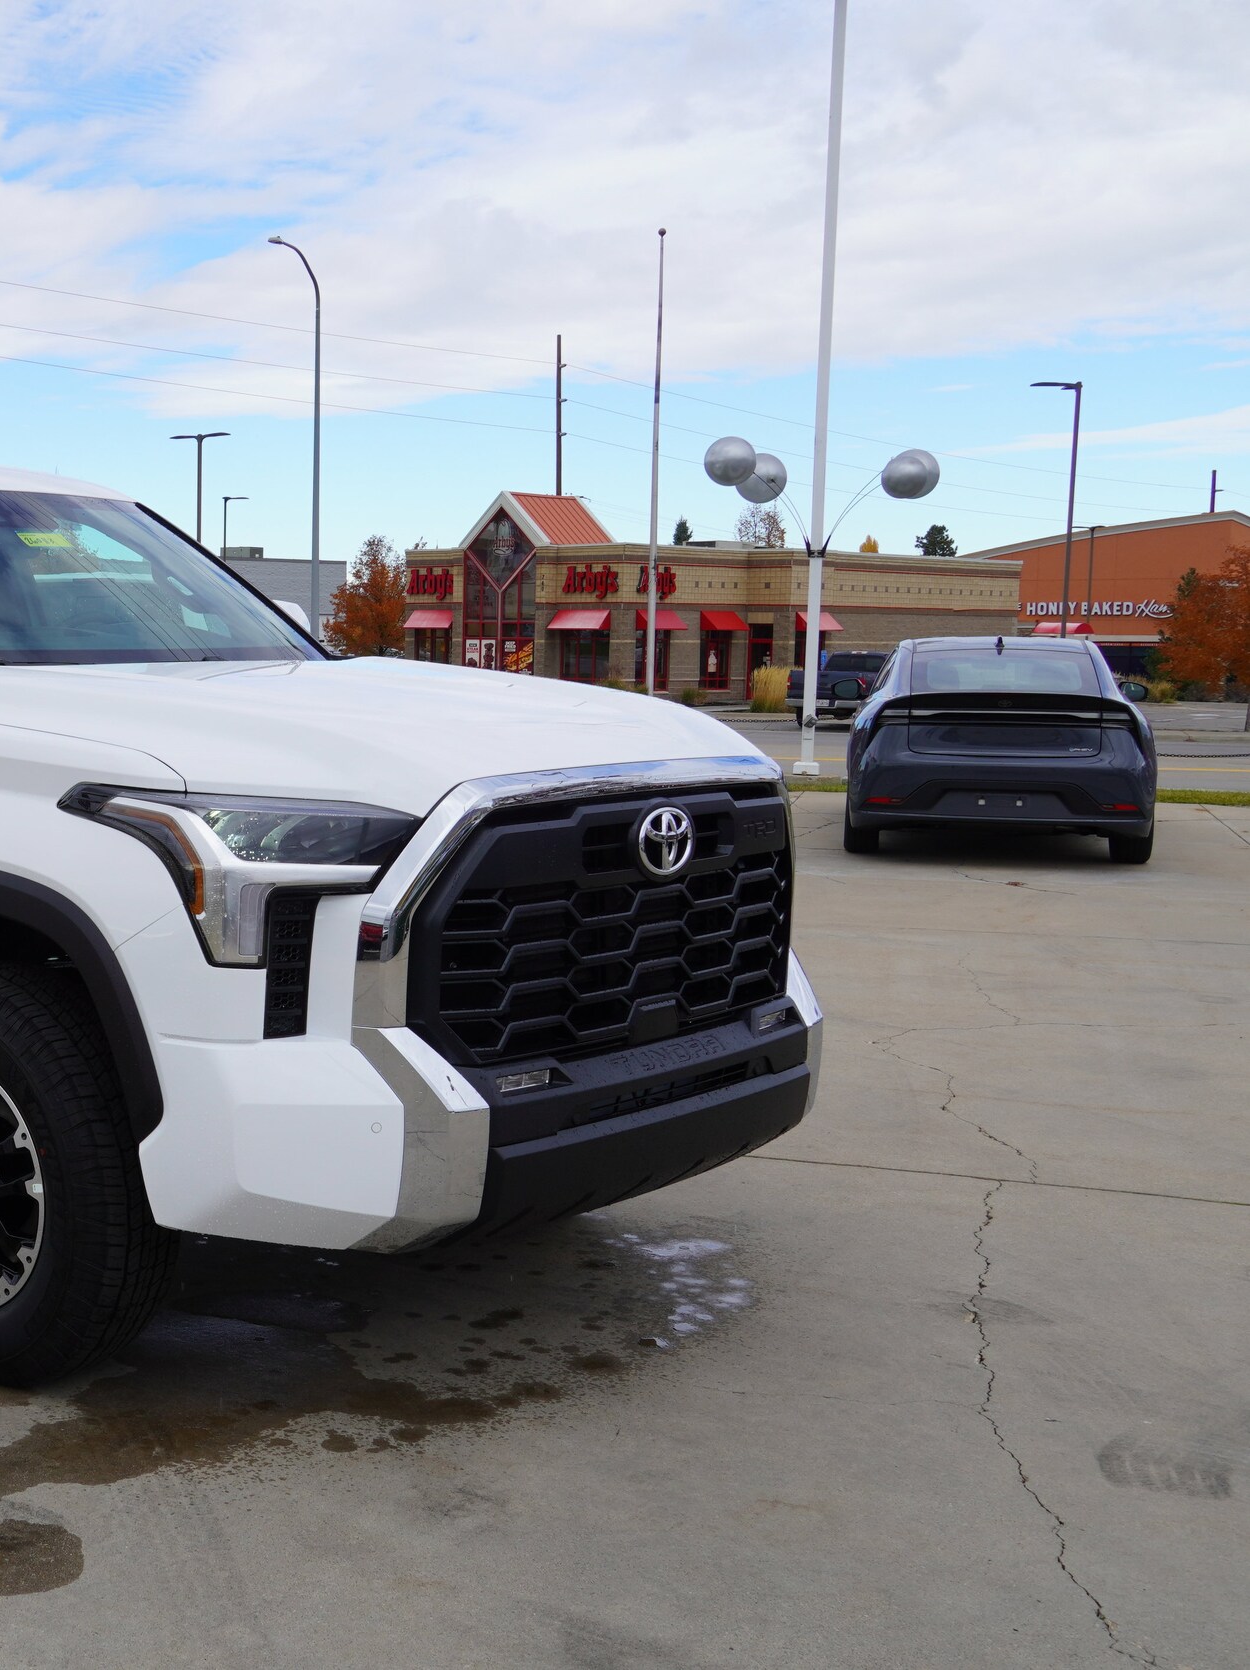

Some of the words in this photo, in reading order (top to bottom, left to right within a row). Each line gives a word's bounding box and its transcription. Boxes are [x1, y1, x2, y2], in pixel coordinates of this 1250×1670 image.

[407, 567, 454, 600] Arby's
[562, 564, 618, 599] Arby's
[637, 565, 676, 599] Aby's
[1081, 602, 1133, 615] BAKED
[606, 1034, 727, 1075] TUNDRA
